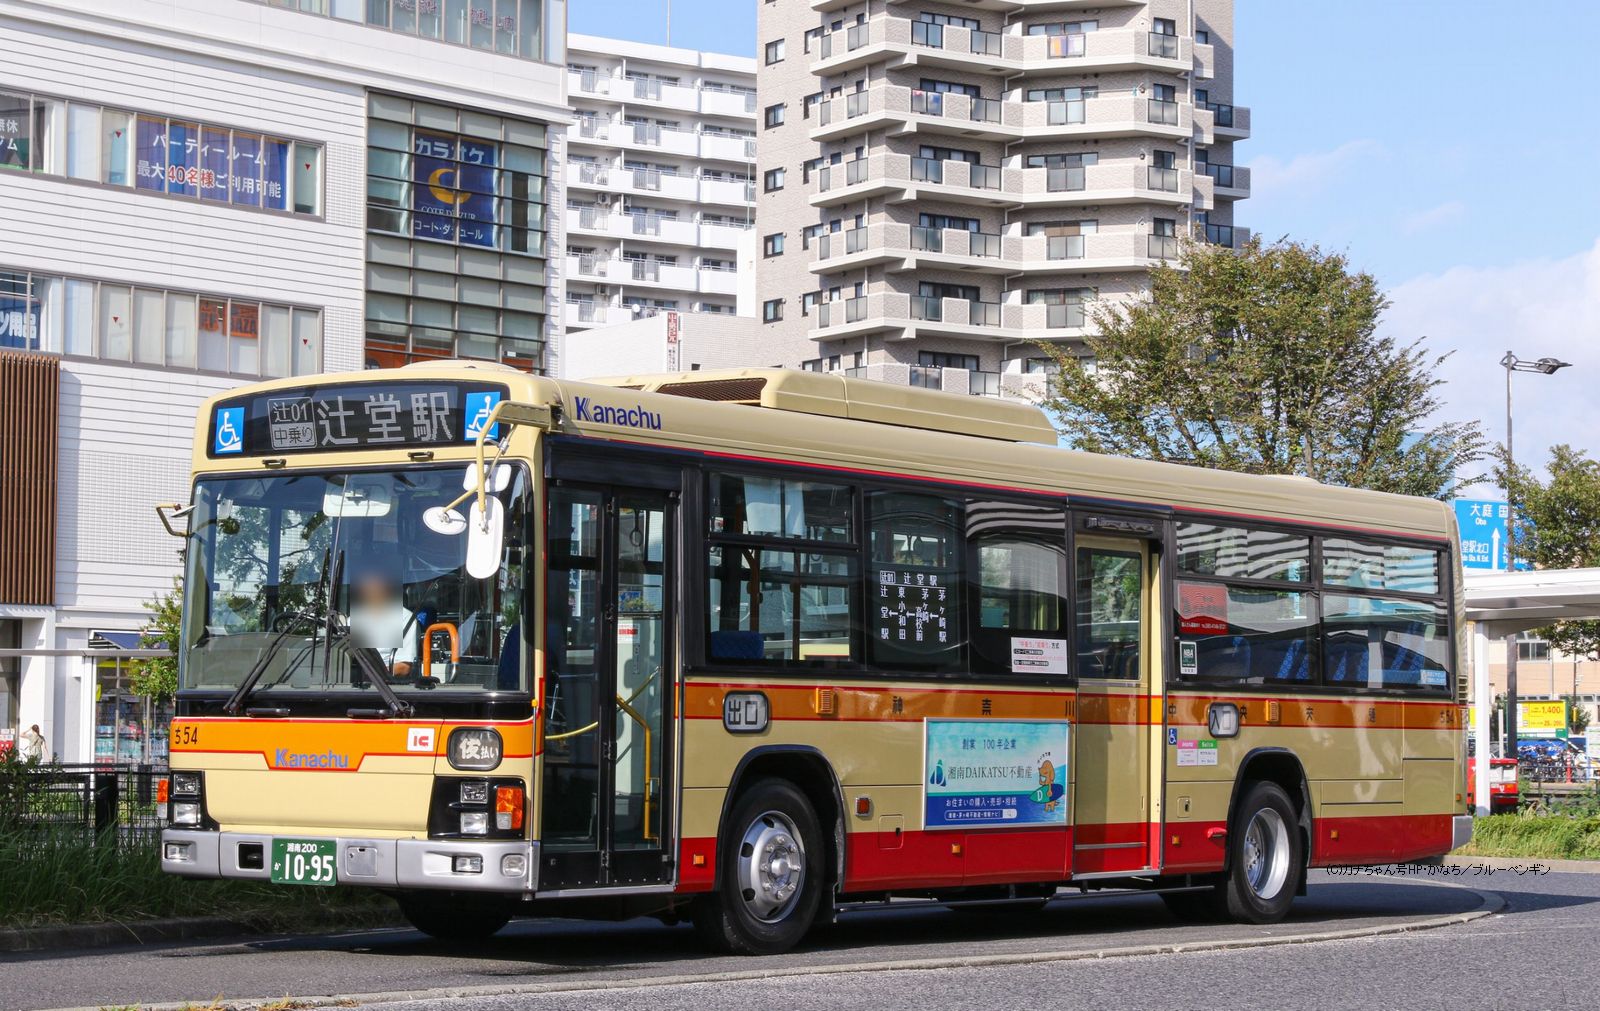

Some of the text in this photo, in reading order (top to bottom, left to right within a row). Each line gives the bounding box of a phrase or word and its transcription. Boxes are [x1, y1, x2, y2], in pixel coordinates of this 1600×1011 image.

[153, 134, 267, 166] パーティールーム
[137, 160, 281, 199] 最大40名様ご利用可能
[273, 400, 308, 423] 辻01
[317, 391, 453, 446] 辻堂駅
[575, 396, 661, 430] Kanachu
[274, 427, 313, 445] 中乗り
[1470, 504, 1492, 518] 大庭
[904, 572, 937, 587] 辻堂駅
[728, 699, 758, 726] 出口
[1211, 709, 1231, 731] 入口
[175, 726, 198, 745] ち54
[275, 747, 348, 768] Kanachu
[947, 766, 1032, 780] 湘南DAIKATSU不動産
[285, 853, 334, 882] 10-95
